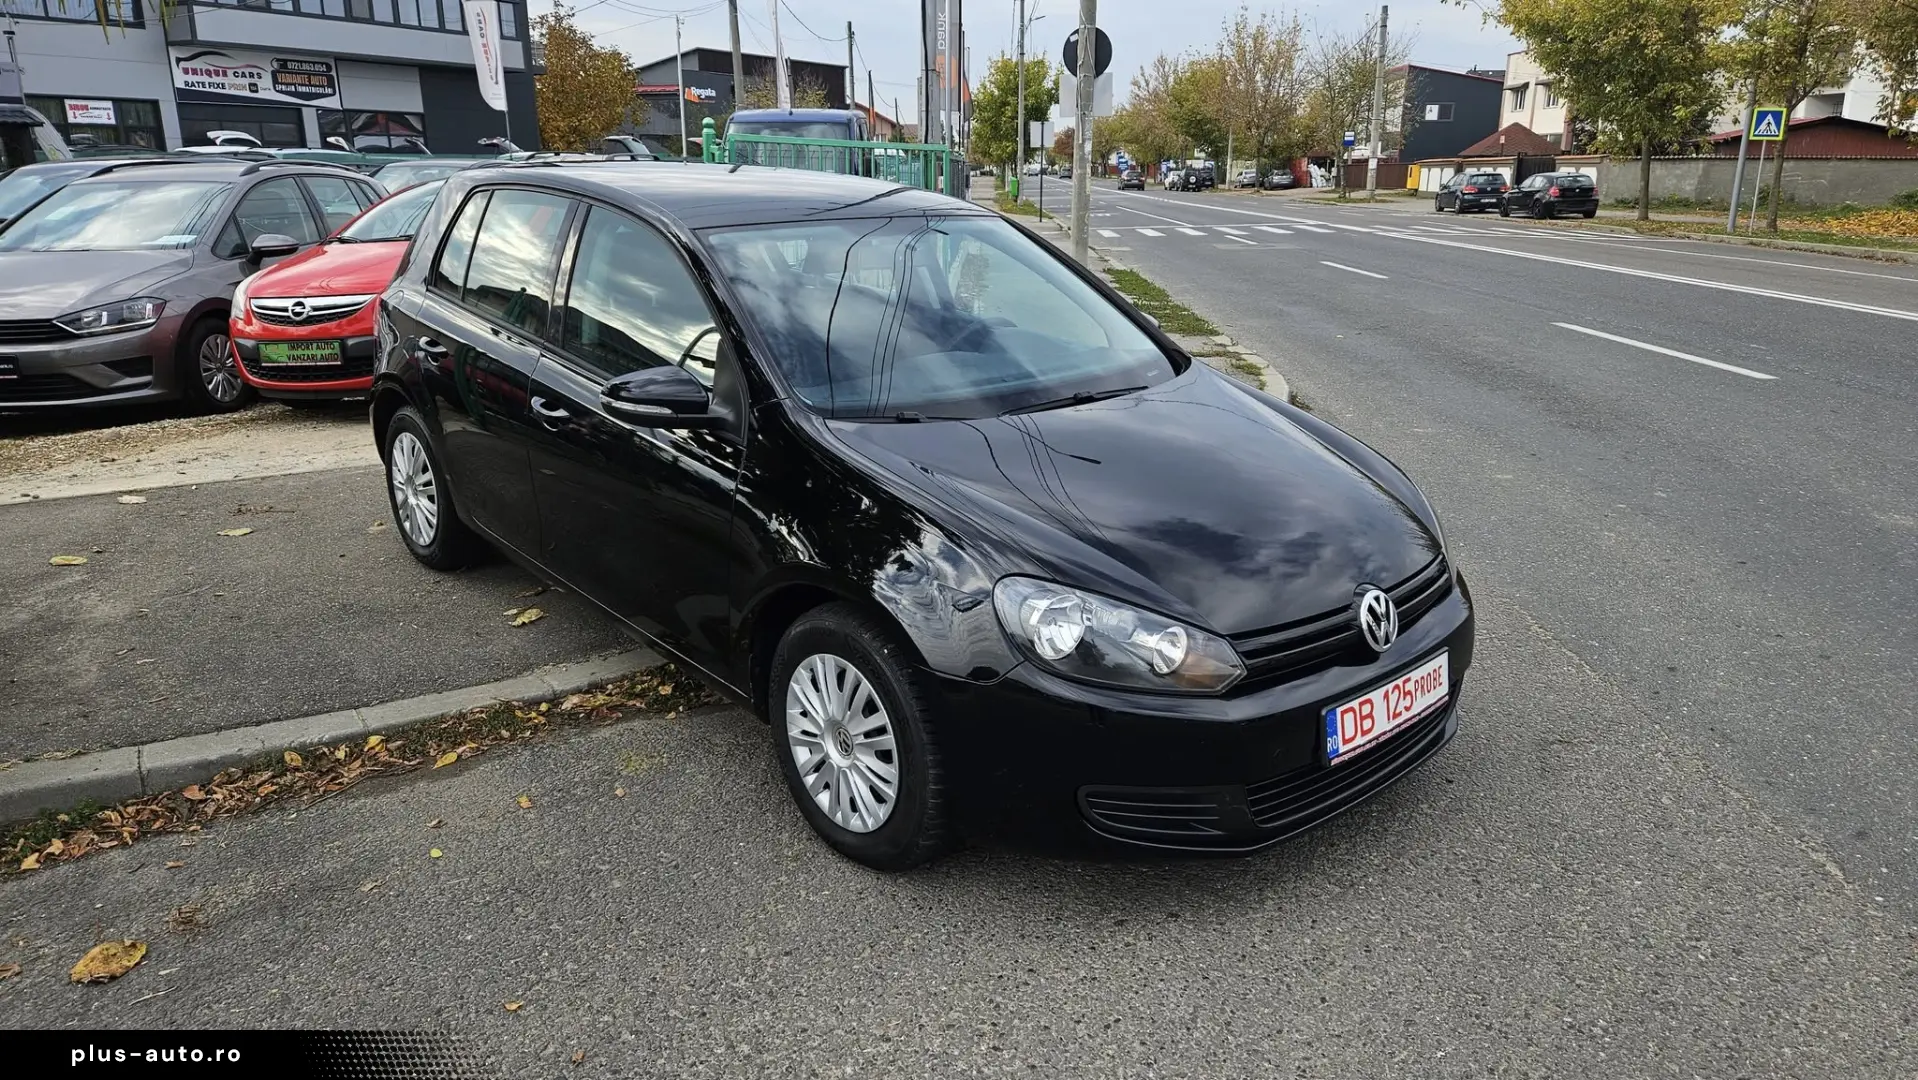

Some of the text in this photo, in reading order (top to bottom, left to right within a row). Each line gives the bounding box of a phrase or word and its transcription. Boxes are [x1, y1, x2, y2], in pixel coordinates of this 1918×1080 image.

[181, 67, 263, 80] UNIQUE CARS
[276, 73, 328, 86] VARIANTE AUTO
[184, 80, 207, 89] RATE
[208, 81, 226, 90] FIXE
[691, 86, 717, 99] Regata
[287, 342, 335, 351] IMPORT AUTO
[286, 352, 339, 362] VANZARI AUTO
[1327, 735, 1338, 753] RO
[1340, 697, 1376, 746] DB
[1382, 676, 1414, 724] 125
[1413, 664, 1443, 703] PROBE
